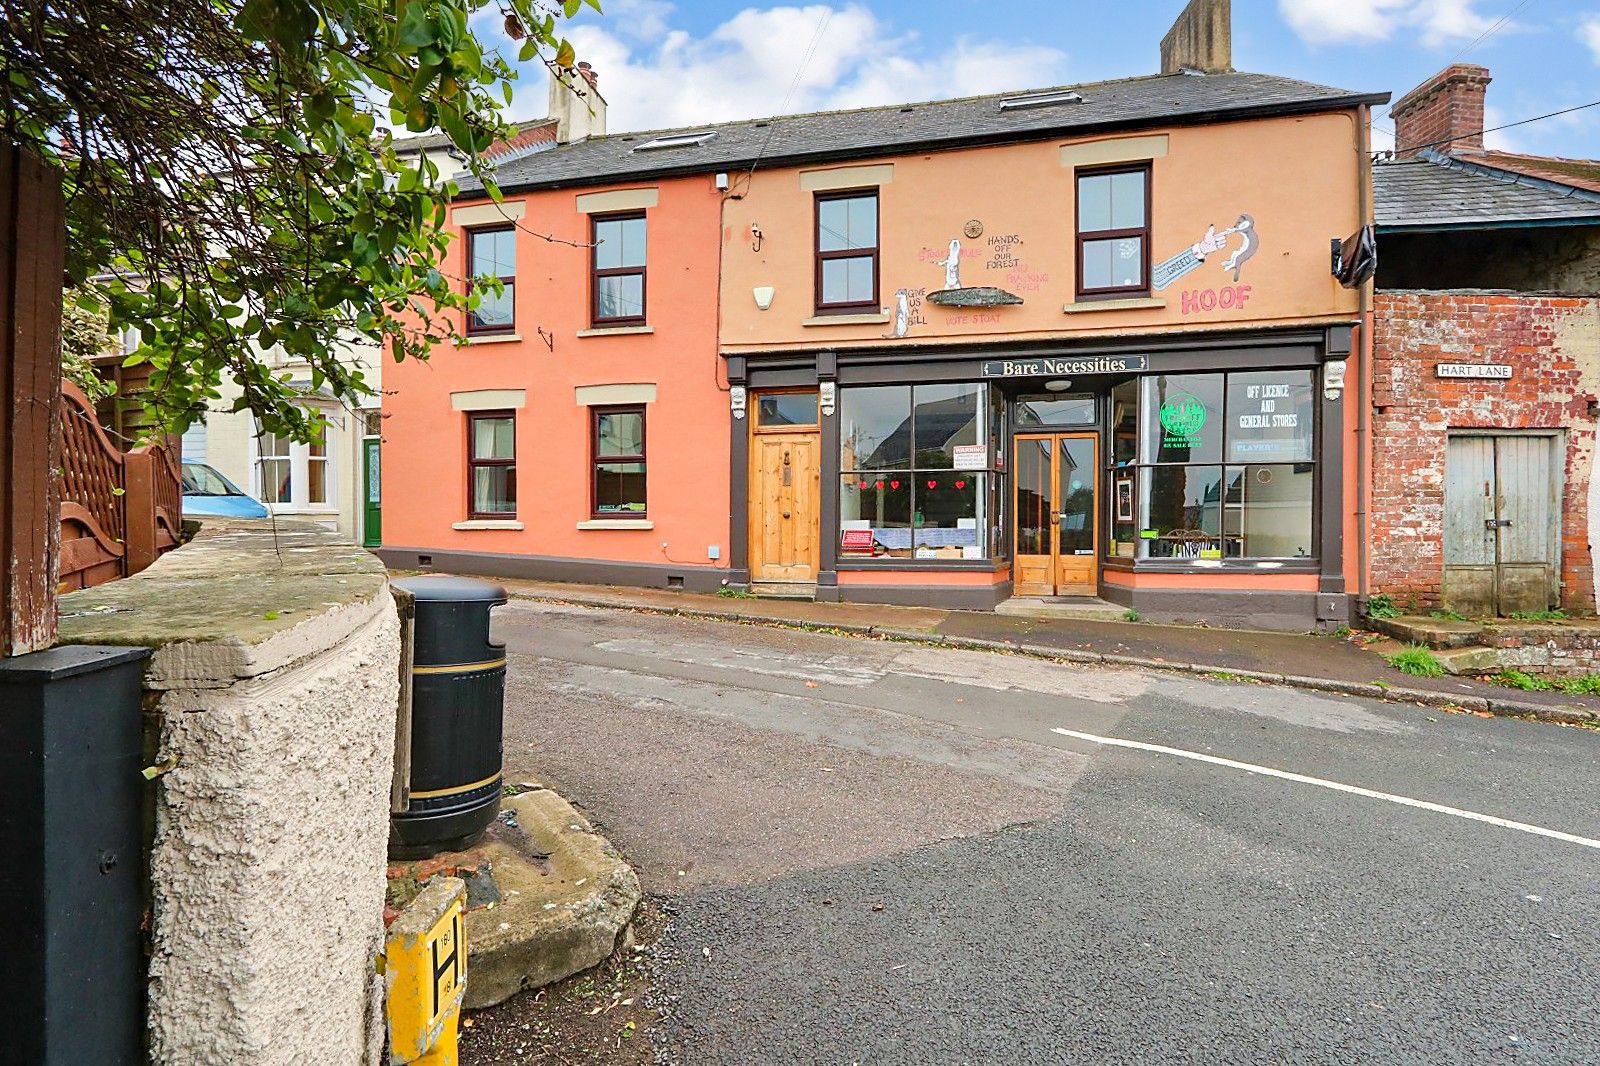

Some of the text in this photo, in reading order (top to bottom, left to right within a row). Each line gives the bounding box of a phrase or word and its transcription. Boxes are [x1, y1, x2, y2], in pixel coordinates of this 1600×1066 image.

[987, 234, 1020, 246] HANDS
[994, 244, 1011, 252] OFF
[994, 252, 1011, 261] OUR
[986, 258, 1019, 270] FOREST
[1166, 255, 1191, 275] GREED
[909, 297, 921, 307] US
[1181, 285, 1252, 315] HOOF
[911, 306, 919, 316] A
[945, 314, 1001, 326] VOTE STOAT
[1003, 357, 1127, 376] Bare Necessities
[1441, 365, 1509, 377] HART LANE
[1246, 384, 1290, 399] OFF LICENCE
[1260, 399, 1275, 413] AND
[1239, 414, 1298, 429] GENERAL STORES
[955, 446, 985, 454] WARNING
[432, 915, 459, 1019] H
